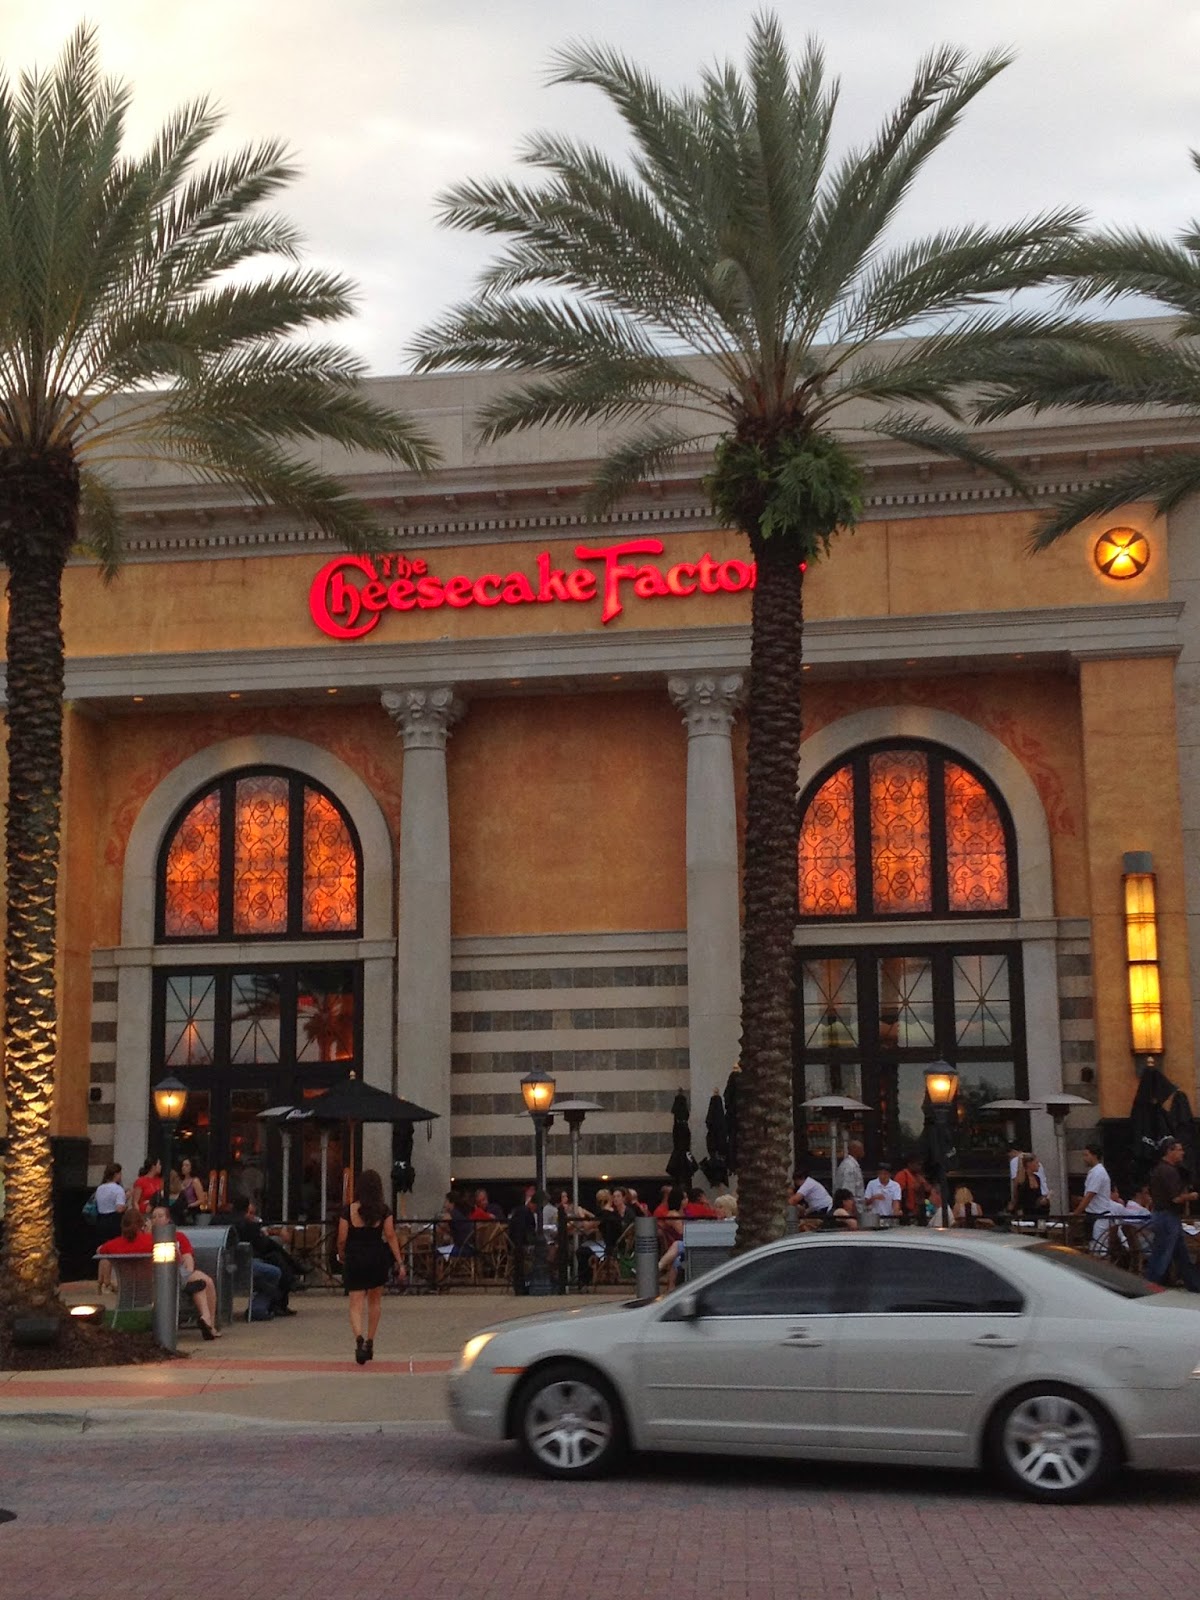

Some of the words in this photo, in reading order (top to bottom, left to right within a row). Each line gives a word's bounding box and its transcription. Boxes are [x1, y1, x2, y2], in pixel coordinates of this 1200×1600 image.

[309, 551, 597, 640] Cheesecake
[574, 538, 807, 625] Facto
[377, 553, 428, 580] The
